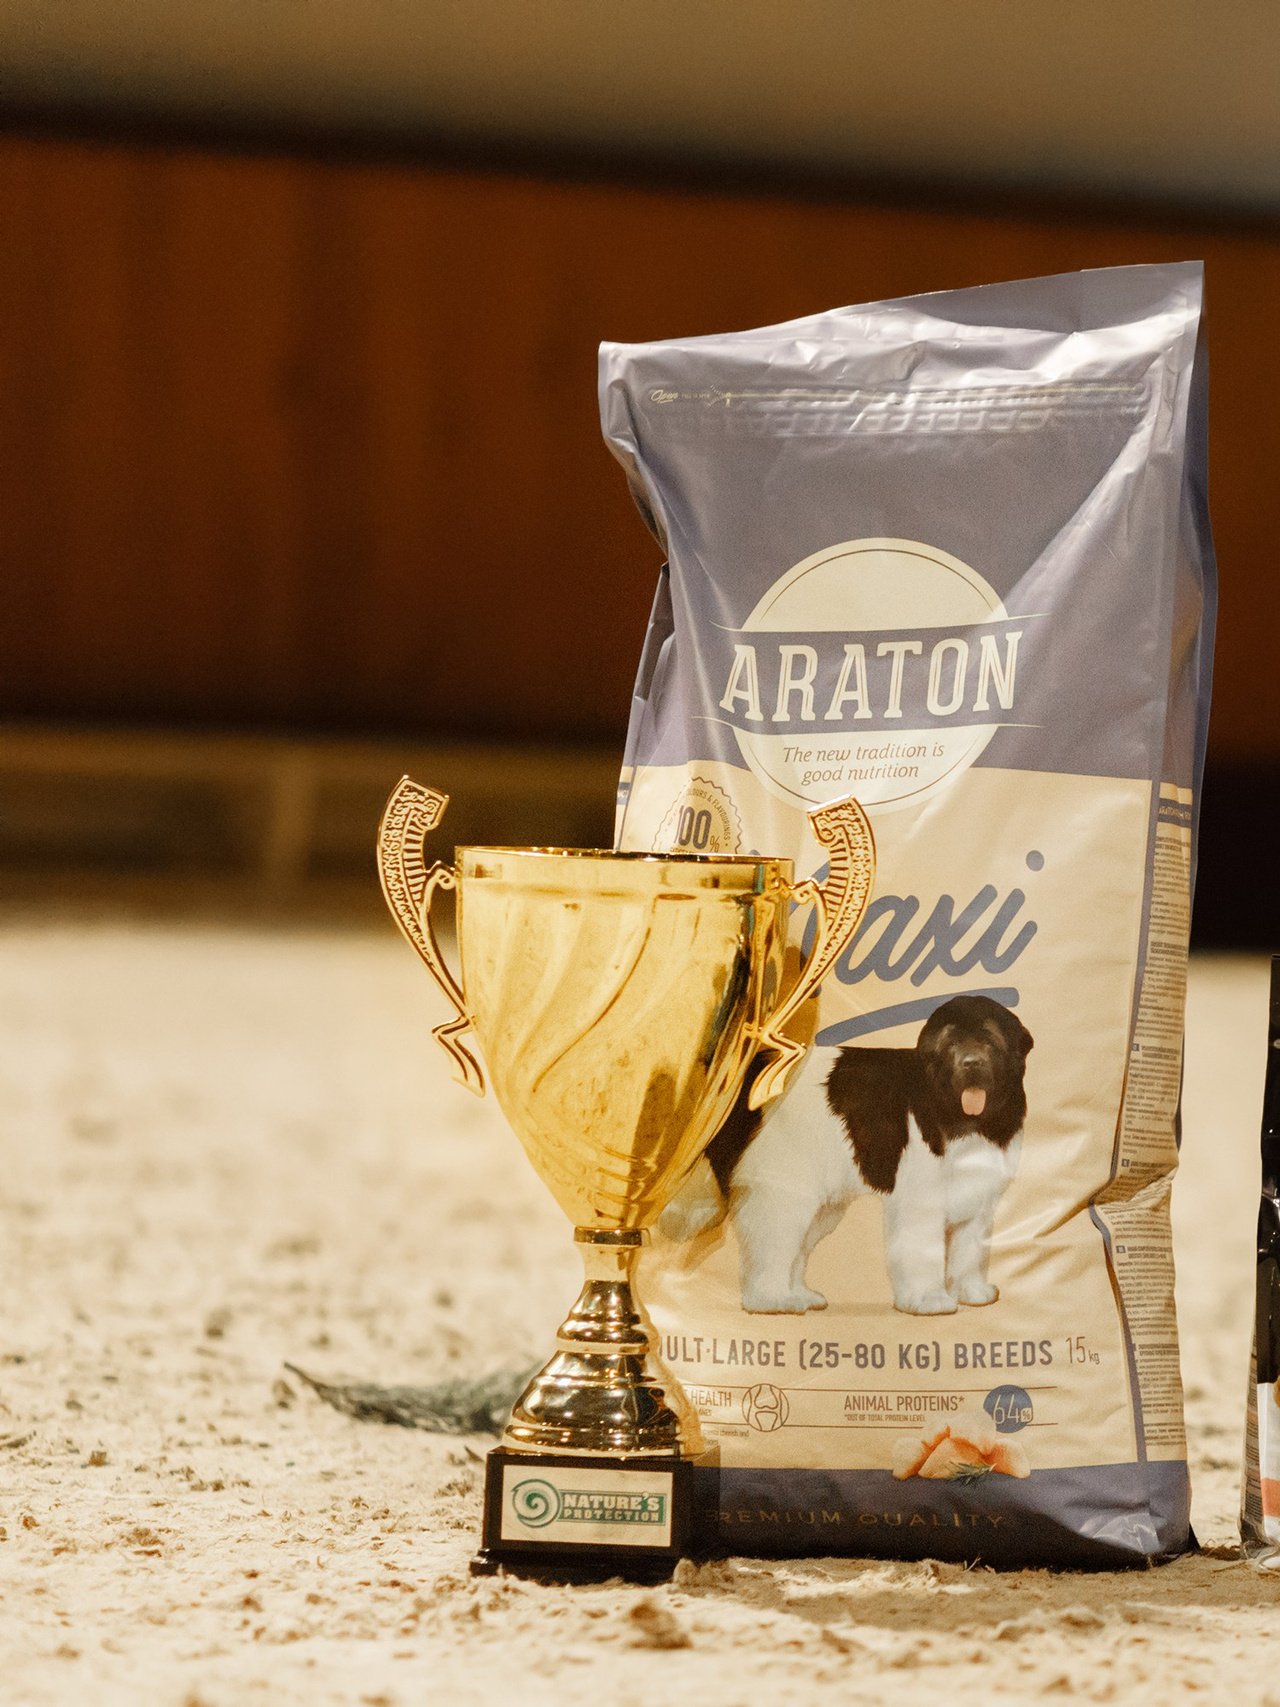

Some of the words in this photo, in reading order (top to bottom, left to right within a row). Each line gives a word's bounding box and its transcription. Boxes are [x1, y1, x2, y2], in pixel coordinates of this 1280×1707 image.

[651, 389, 679, 404] Open
[719, 631, 1022, 722] ARATON
[783, 746, 806, 763] The
[816, 748, 850, 762] new
[855, 743, 927, 761] tradition
[932, 741, 945, 758] is
[800, 765, 843, 786] good
[847, 763, 919, 781] nutrition
[799, 1338, 887, 1371] (25-80
[898, 1340, 941, 1371] KG)
[954, 1340, 1054, 1370] BREEDS
[691, 1390, 732, 1407] HEALTH
[844, 1395, 893, 1412] ANIMAL
[859, 1414, 867, 1422] OF
[868, 1414, 884, 1422] TOTAL
[886, 1414, 909, 1423] PROTEIN
[909, 1414, 926, 1423] LEVEL
[564, 1491, 660, 1511] NATURE'S
[563, 1509, 660, 1523] PROTECTION
[712, 1510, 842, 1526] REMIUM
[858, 1512, 1003, 1528] QUALITY
